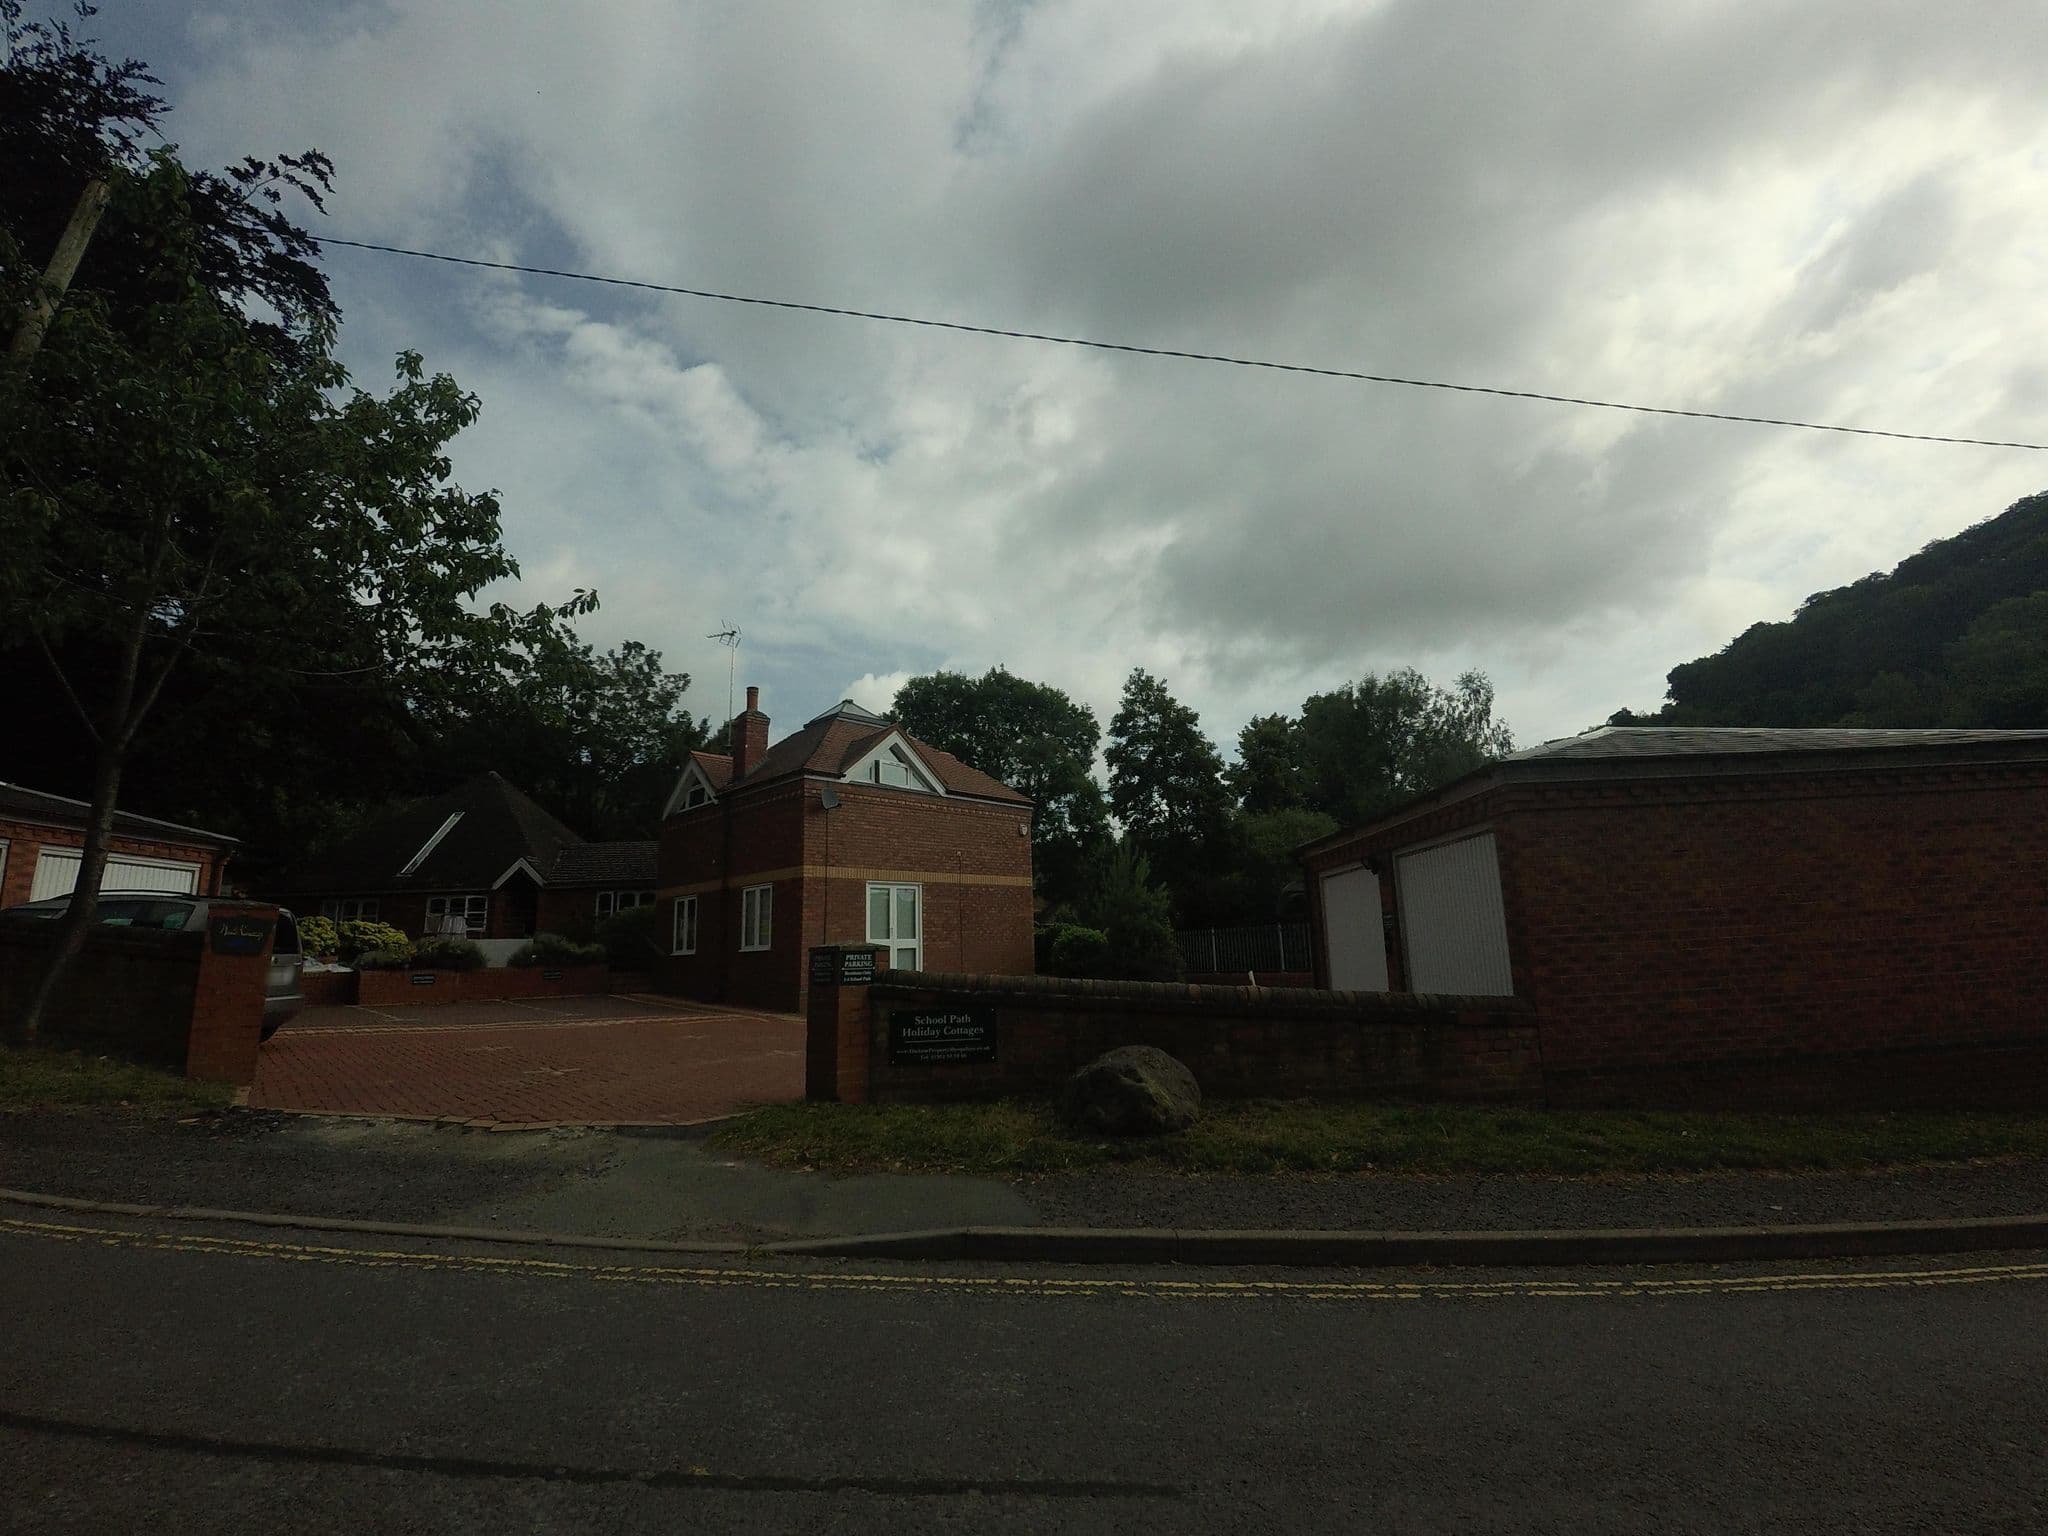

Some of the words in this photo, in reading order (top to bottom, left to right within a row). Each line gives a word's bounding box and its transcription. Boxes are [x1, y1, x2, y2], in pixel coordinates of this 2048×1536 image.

[914, 1015, 947, 1025] School
[950, 1014, 971, 1024] Path
[902, 1027, 941, 1038] Holiday
[943, 1026, 984, 1037] Cottages
